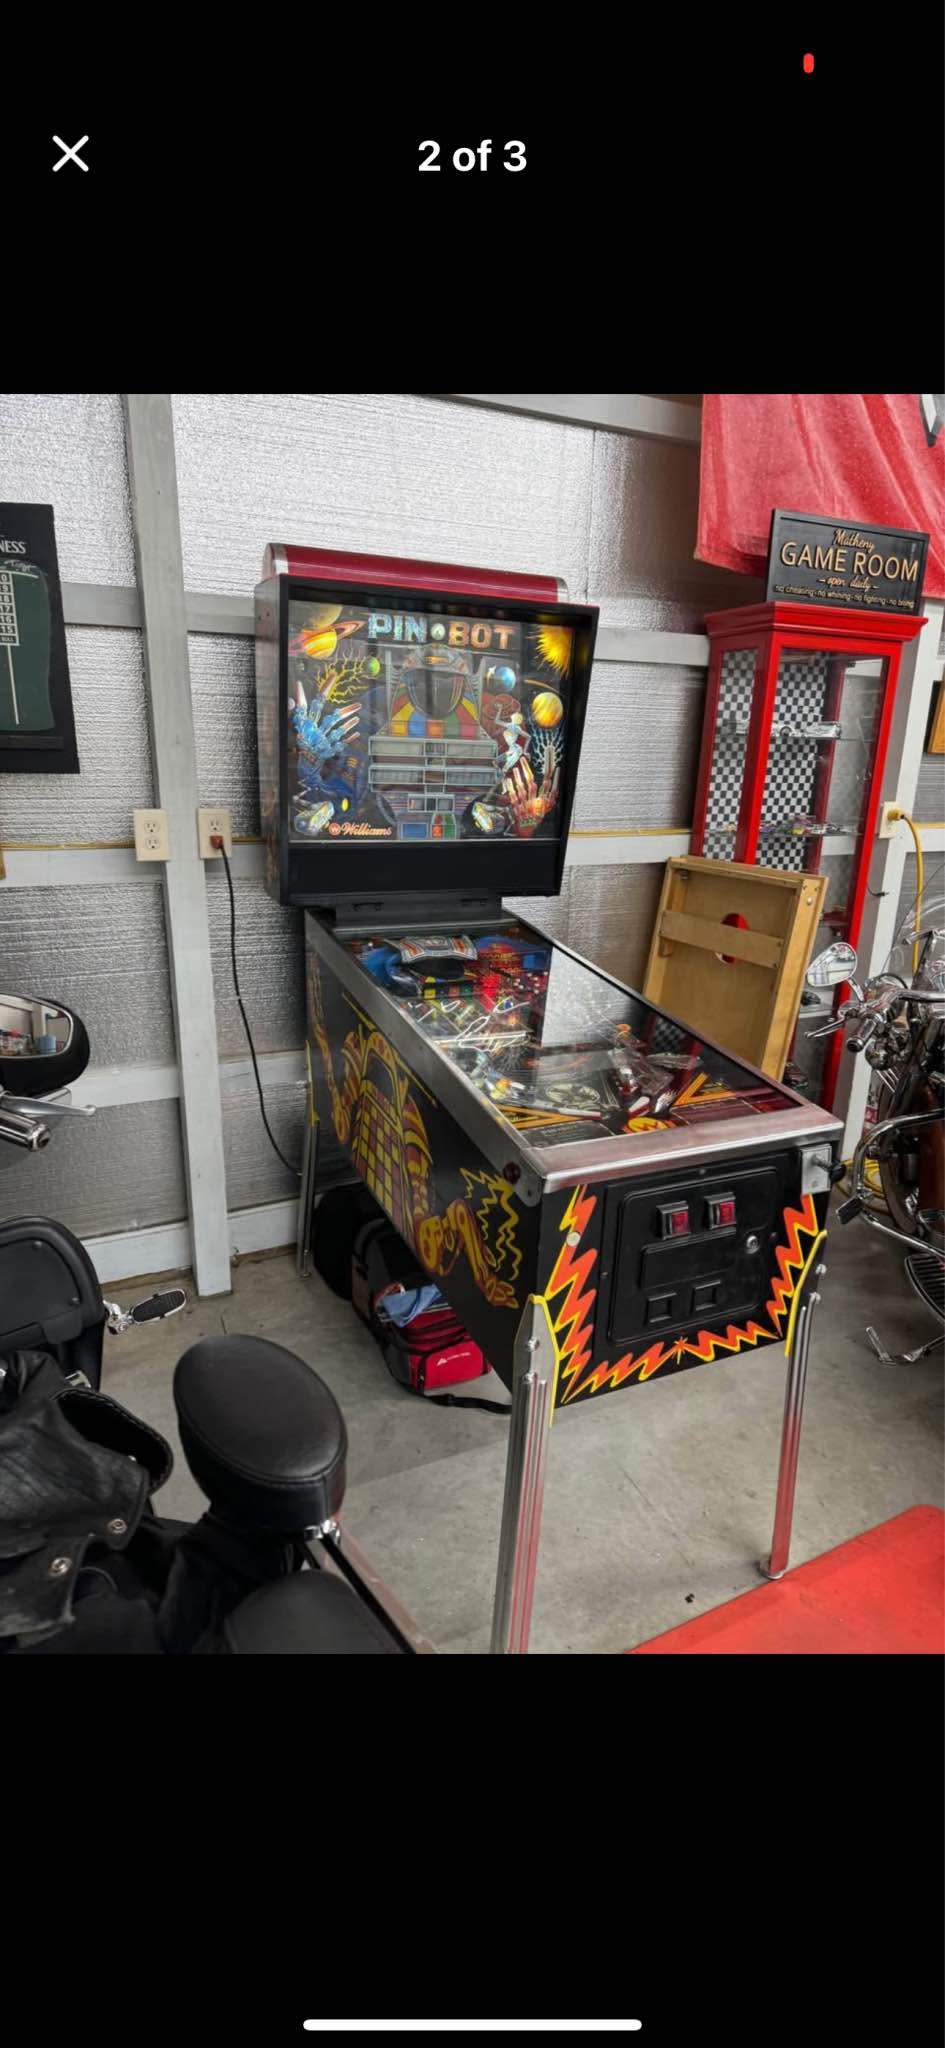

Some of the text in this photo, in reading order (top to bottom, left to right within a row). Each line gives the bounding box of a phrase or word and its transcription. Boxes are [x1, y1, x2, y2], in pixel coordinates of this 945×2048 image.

[833, 528, 875, 553] Matheny
[780, 541, 919, 582] GAME ROOM
[826, 575, 871, 592] open daily
[367, 613, 516, 650] PIN BOT
[341, 822, 393, 836] Williams
